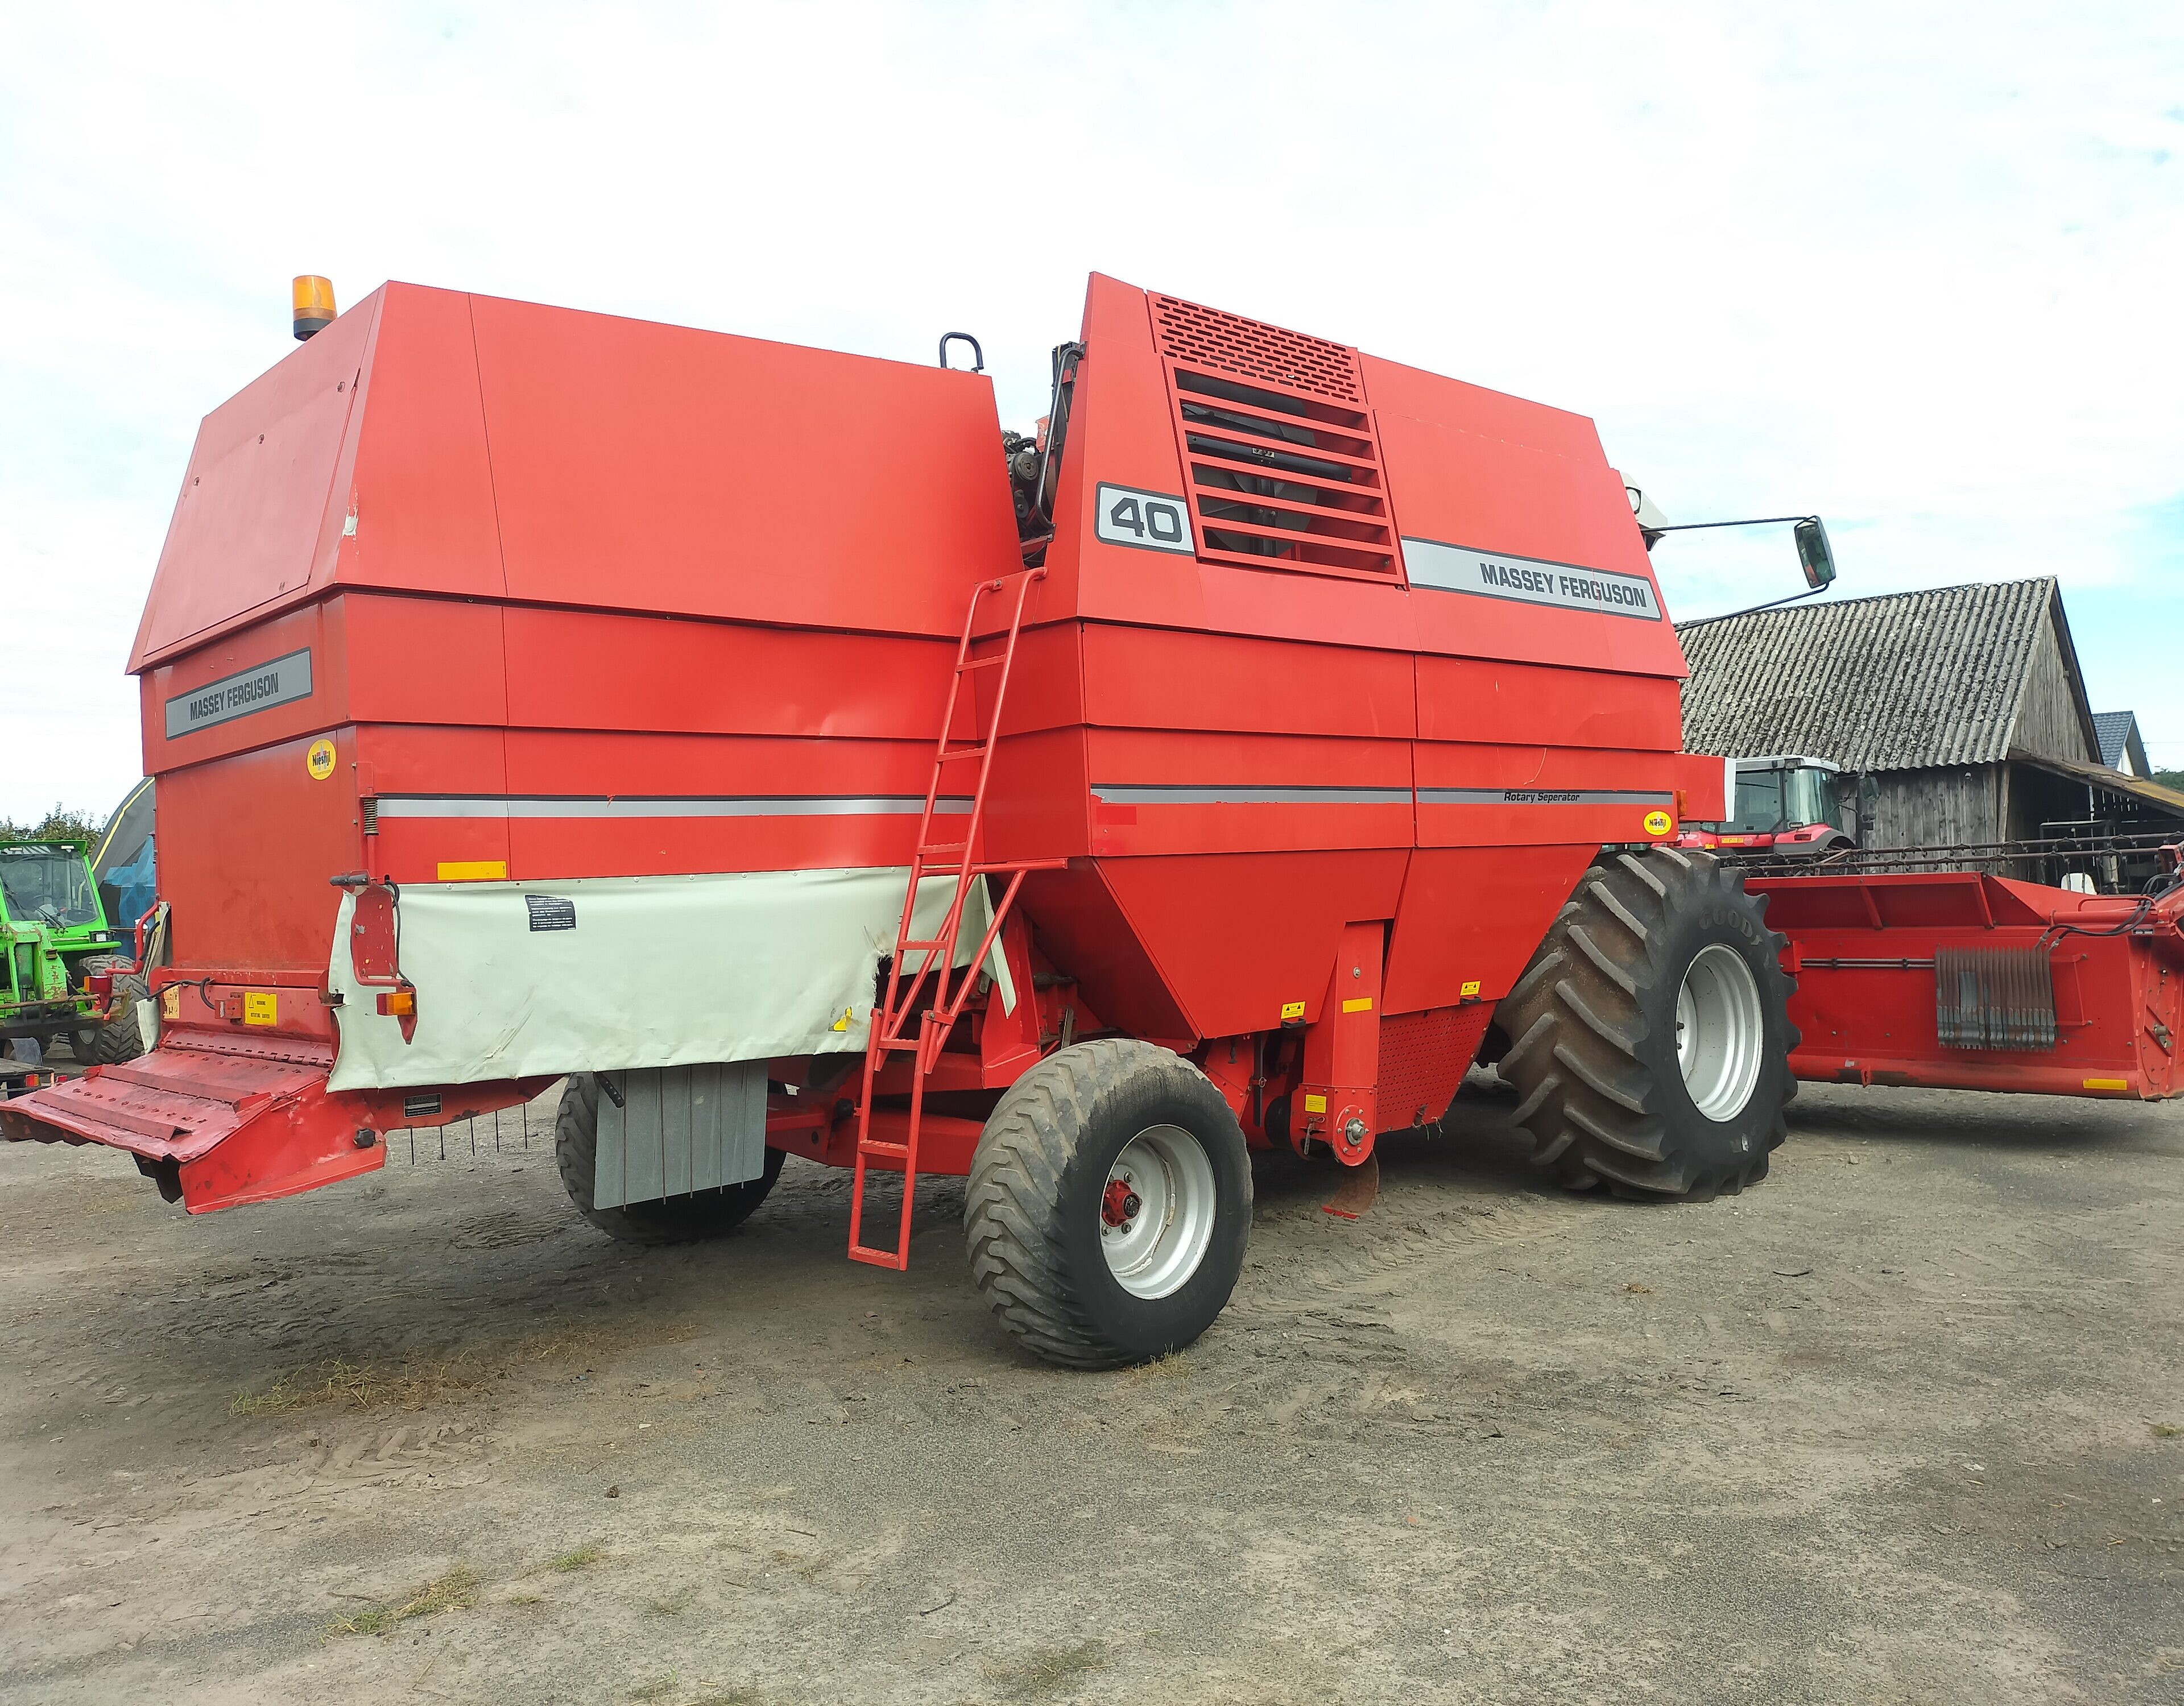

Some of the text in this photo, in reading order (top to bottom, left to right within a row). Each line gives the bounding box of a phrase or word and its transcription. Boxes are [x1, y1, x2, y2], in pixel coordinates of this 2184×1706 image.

[1111, 498, 1182, 543] 40
[1479, 562, 1647, 607] MASSEY FERGUSON
[190, 672, 279, 721] MASSEY FERGUSON
[1504, 792, 1580, 803] Rotary Seperator
